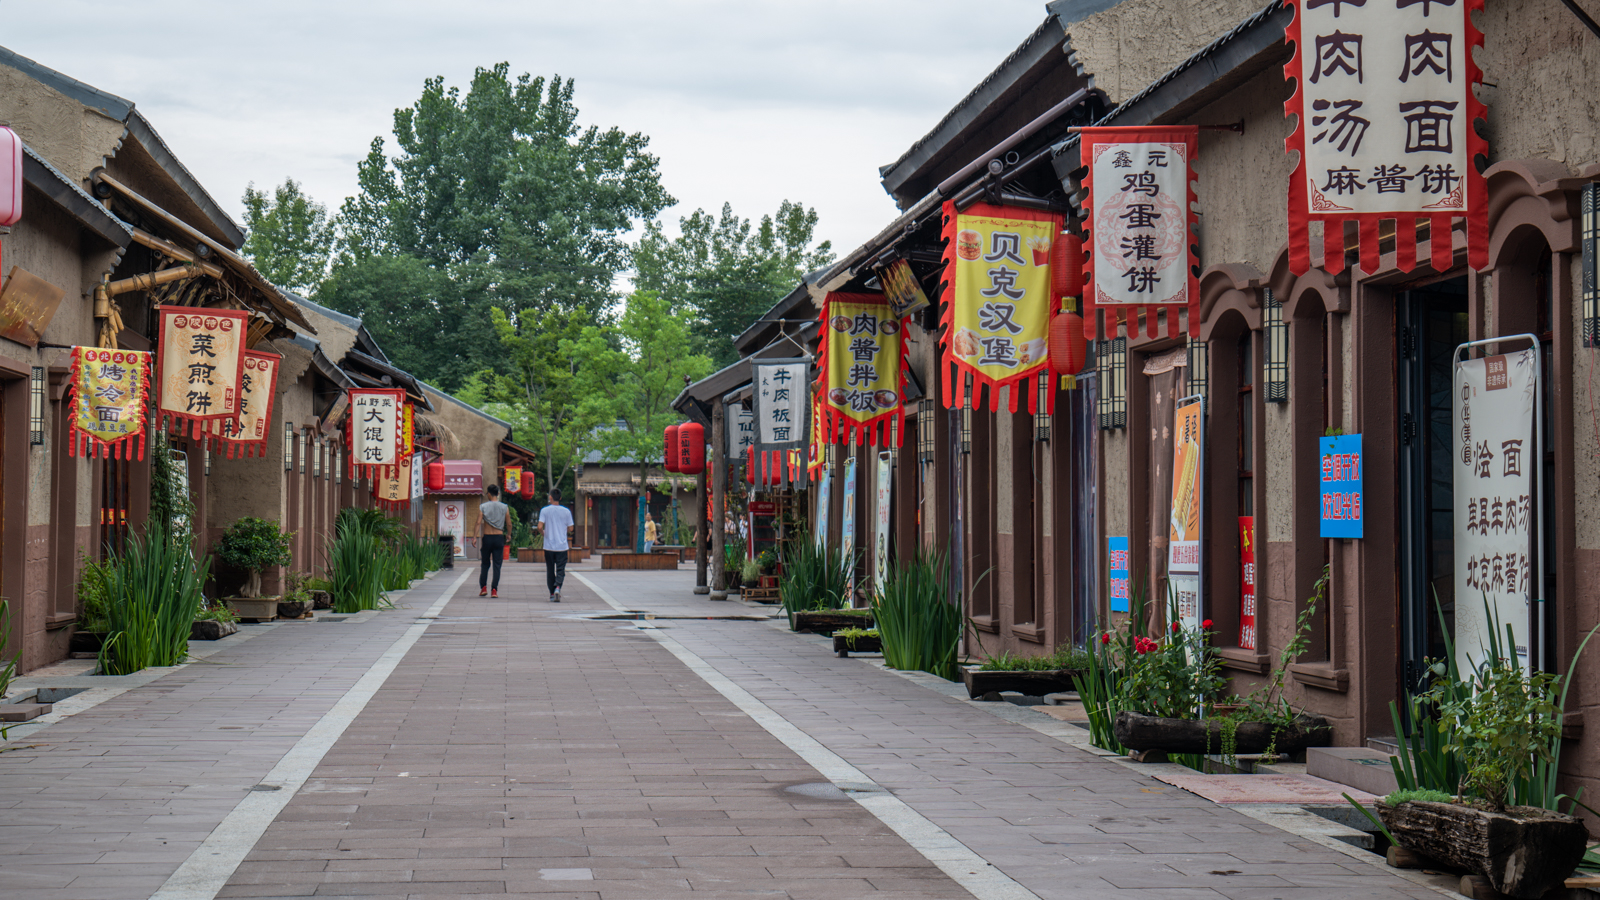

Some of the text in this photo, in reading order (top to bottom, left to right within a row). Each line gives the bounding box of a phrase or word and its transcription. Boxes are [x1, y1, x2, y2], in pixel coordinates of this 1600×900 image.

[1322, 164, 1459, 195] 麻酱饼
[1119, 170, 1162, 293] 鸡蛋灌饼
[979, 232, 1026, 368] 贝克汉堡
[174, 316, 233, 331] 马陵特色
[86, 351, 137, 363] 东北正宗
[186, 333, 217, 415] 菜煎饼
[848, 312, 879, 413] 肉酱拌饭
[95, 364, 126, 422] 烤冷面
[357, 398, 392, 407] 山野菜
[772, 368, 791, 441] 牛肉板面
[87, 421, 128, 433] 现磨豆浆
[363, 408, 385, 461] 大馄饨
[1462, 383, 1471, 465] 中华美食
[1322, 452, 1360, 482] 空调开放
[1474, 440, 1523, 478] 烩面
[1322, 492, 1360, 520] 欢迎光临
[1467, 495, 1529, 535] 单县羊肉汤
[1467, 552, 1528, 594] 北京麻酱饼
